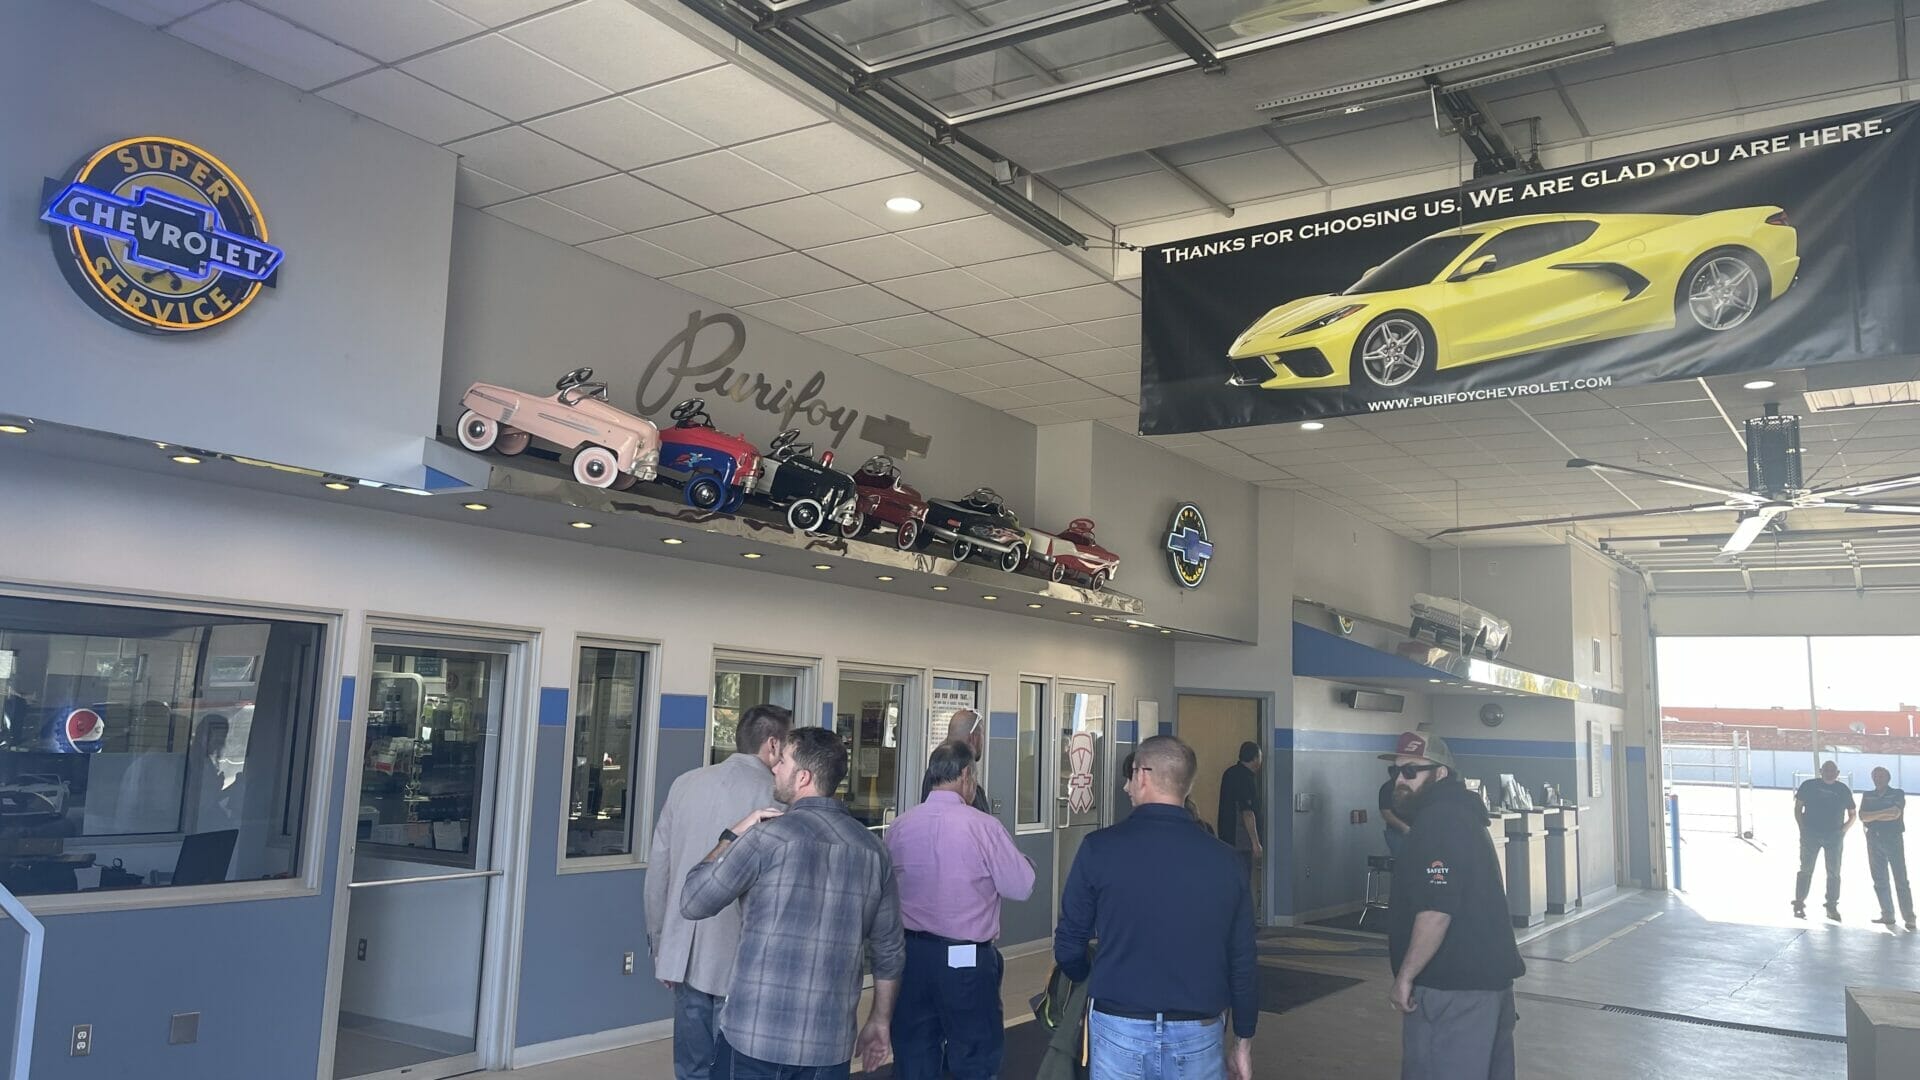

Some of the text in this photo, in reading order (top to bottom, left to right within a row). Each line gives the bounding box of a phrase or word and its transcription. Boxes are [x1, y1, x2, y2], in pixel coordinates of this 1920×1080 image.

[117, 144, 230, 205] SUPER
[1161, 118, 1892, 264] THANKS FOR CHOOSING US. WE ARE GLAD YOU ARE HERE.
[68, 196, 262, 272] CHEVROLET
[94, 256, 233, 325] SERVICE
[635, 309, 859, 450] Purifoy
[1368, 375, 1613, 412] WWW.PURIFOYCHEVROLET.COM
